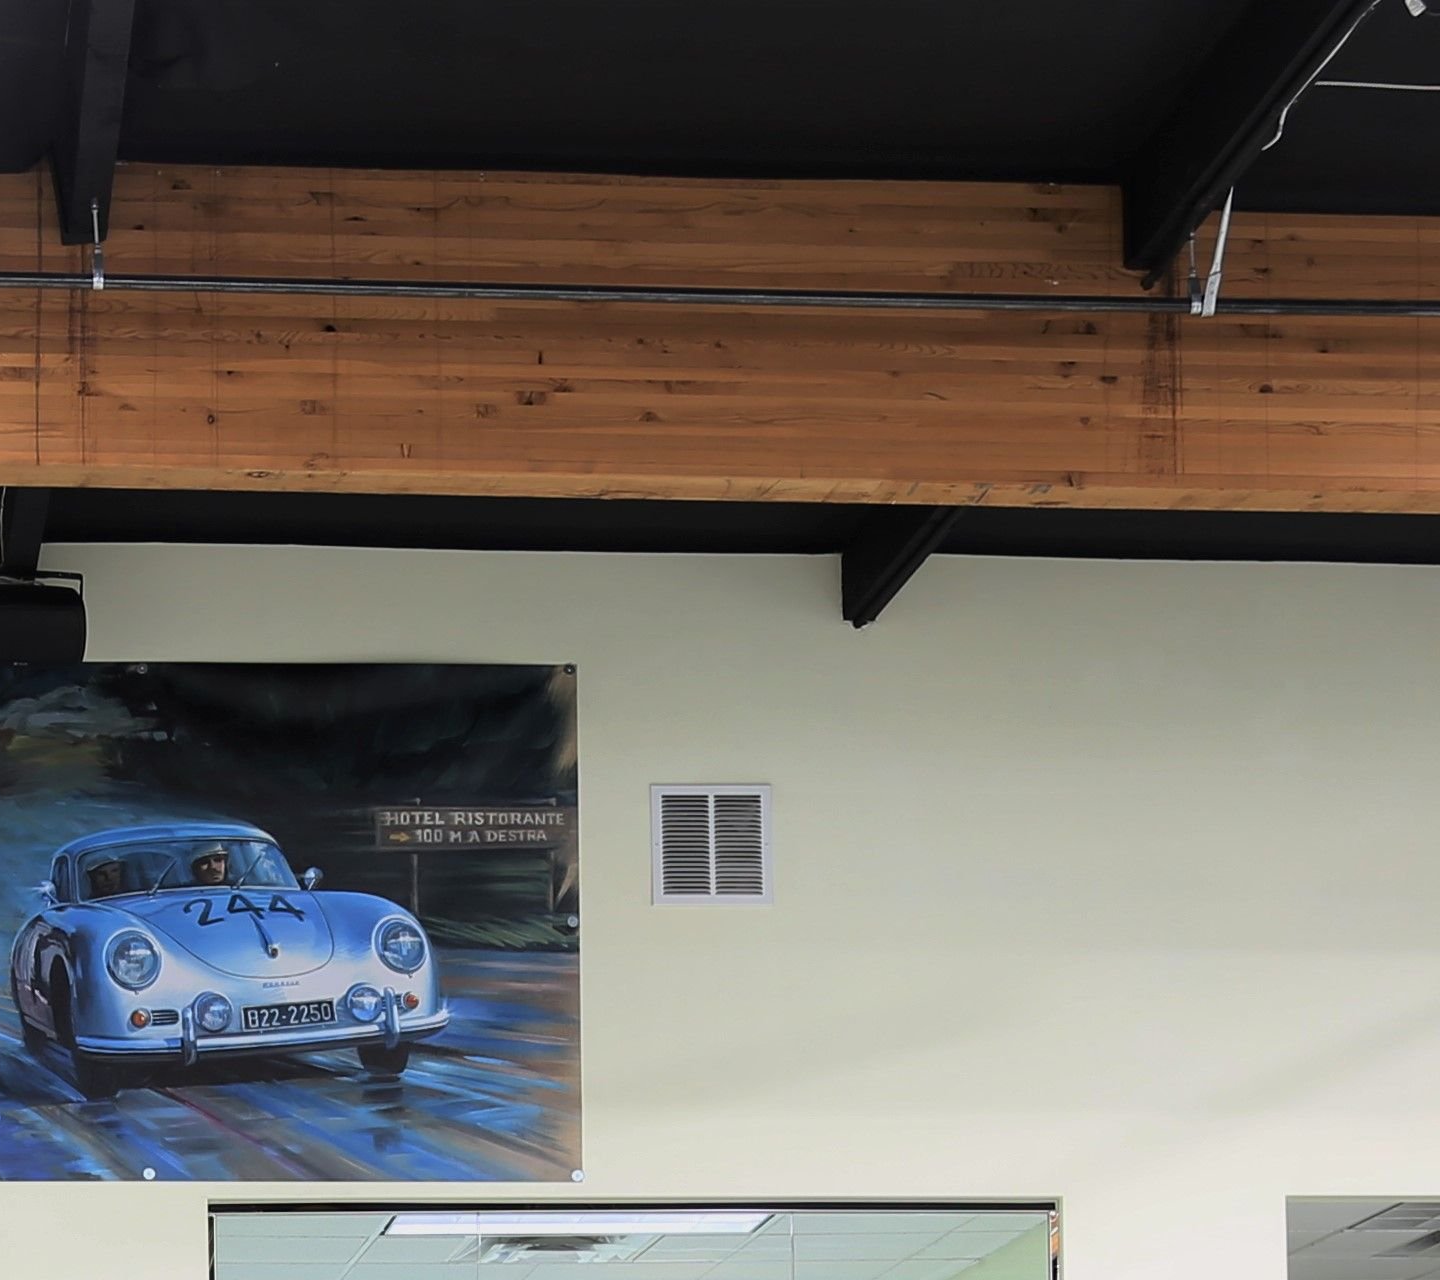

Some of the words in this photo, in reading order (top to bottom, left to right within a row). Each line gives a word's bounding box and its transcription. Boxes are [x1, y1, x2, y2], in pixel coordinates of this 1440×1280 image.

[385, 811, 445, 826] HOTEL
[454, 811, 565, 826] RISTORANTE
[415, 828, 443, 843] 100
[468, 829, 481, 843] A
[487, 829, 548, 843] DESTRA
[183, 893, 307, 926] 244
